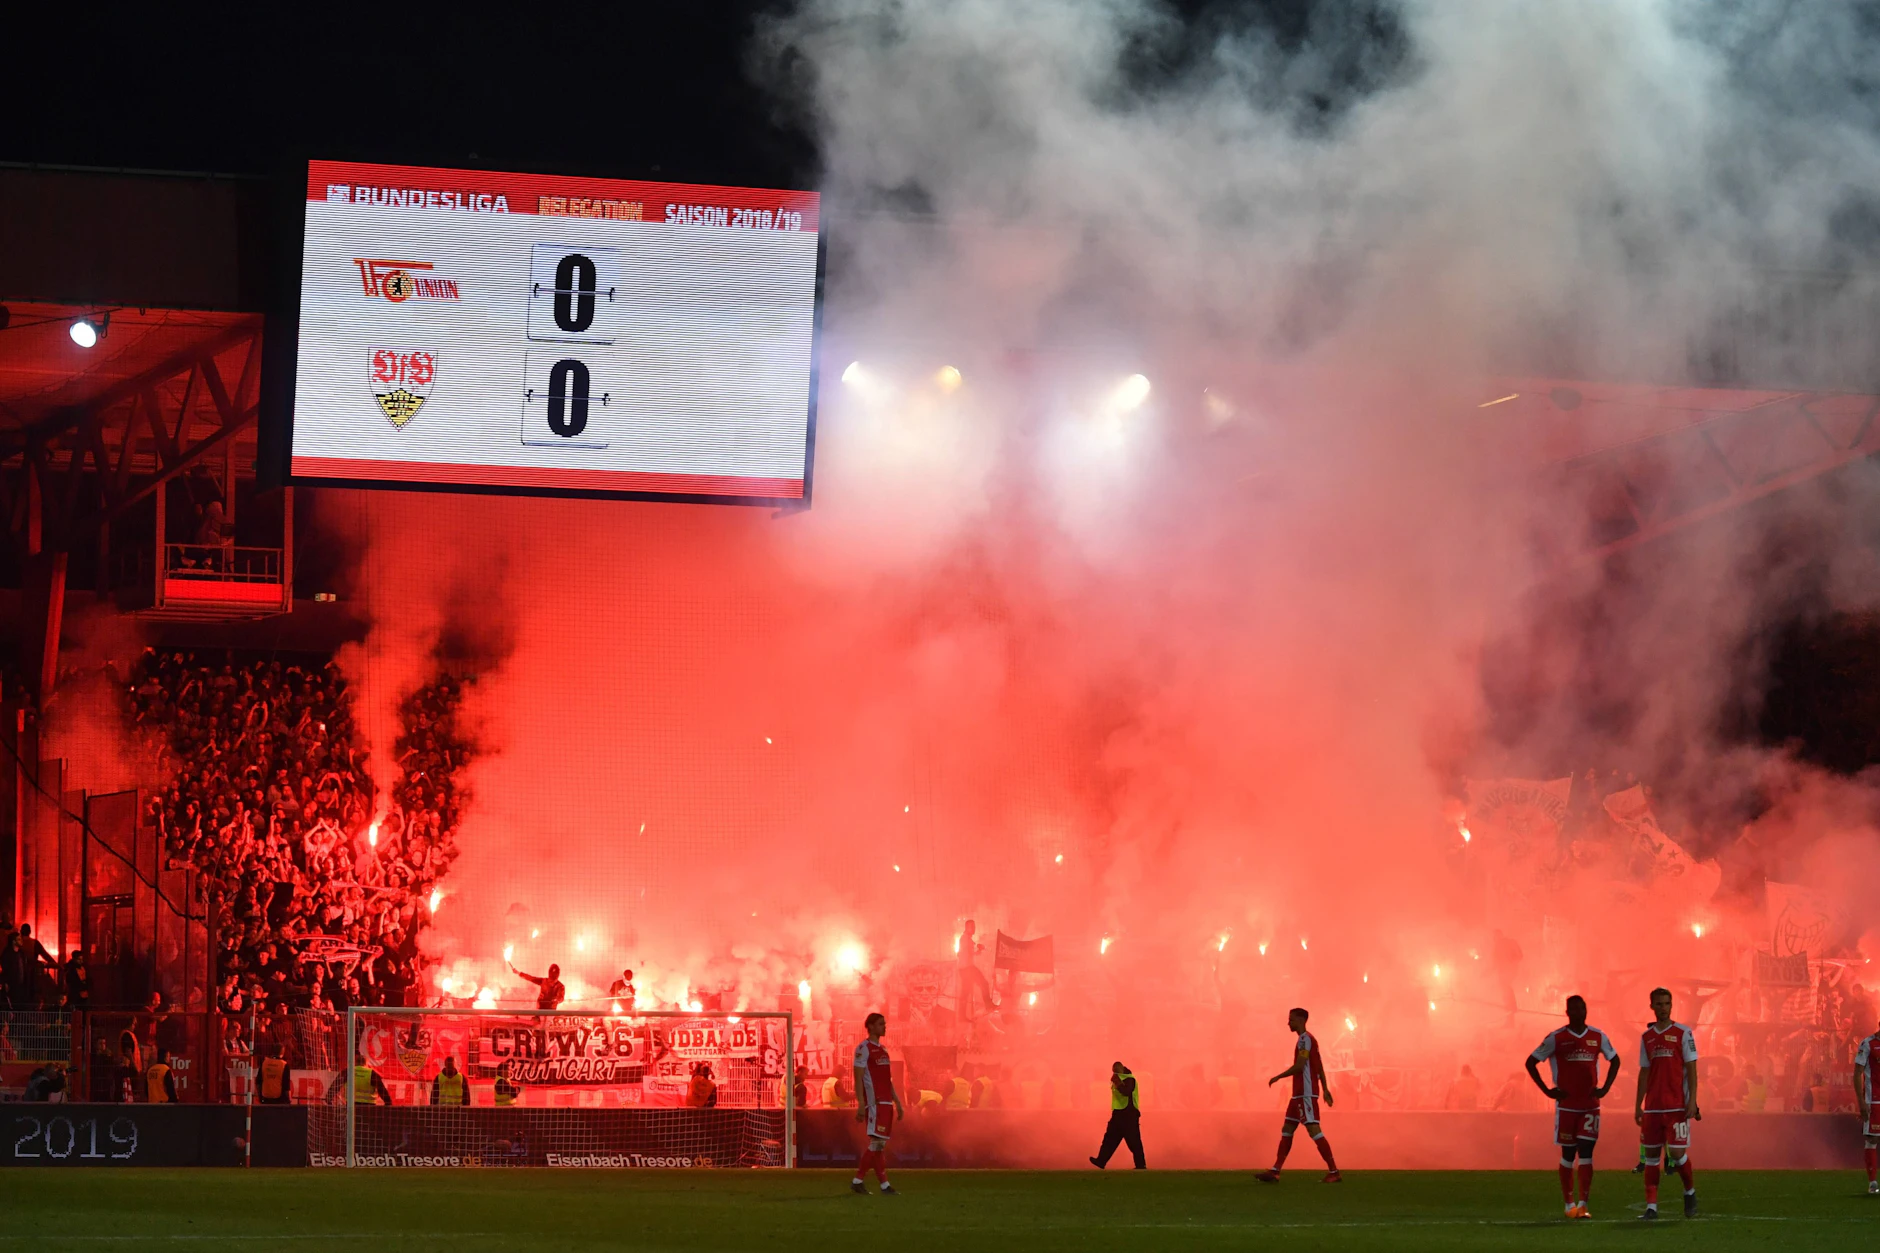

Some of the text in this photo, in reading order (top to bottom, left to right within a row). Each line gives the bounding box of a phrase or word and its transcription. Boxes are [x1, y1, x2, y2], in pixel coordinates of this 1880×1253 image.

[354, 185, 510, 214] BUNDESLIGA
[538, 196, 644, 222] RELEGATION
[665, 203, 802, 231] SAISON 2018/19
[412, 278, 460, 300] UNION
[553, 253, 597, 333] 0
[547, 358, 591, 438] 0
[170, 1056, 191, 1070] Tor
[506, 1058, 619, 1082] STUTTGART
[14, 1116, 138, 1160] 2019
[1673, 1121, 1687, 1139] 10
[546, 1153, 630, 1168] Eisenbach
